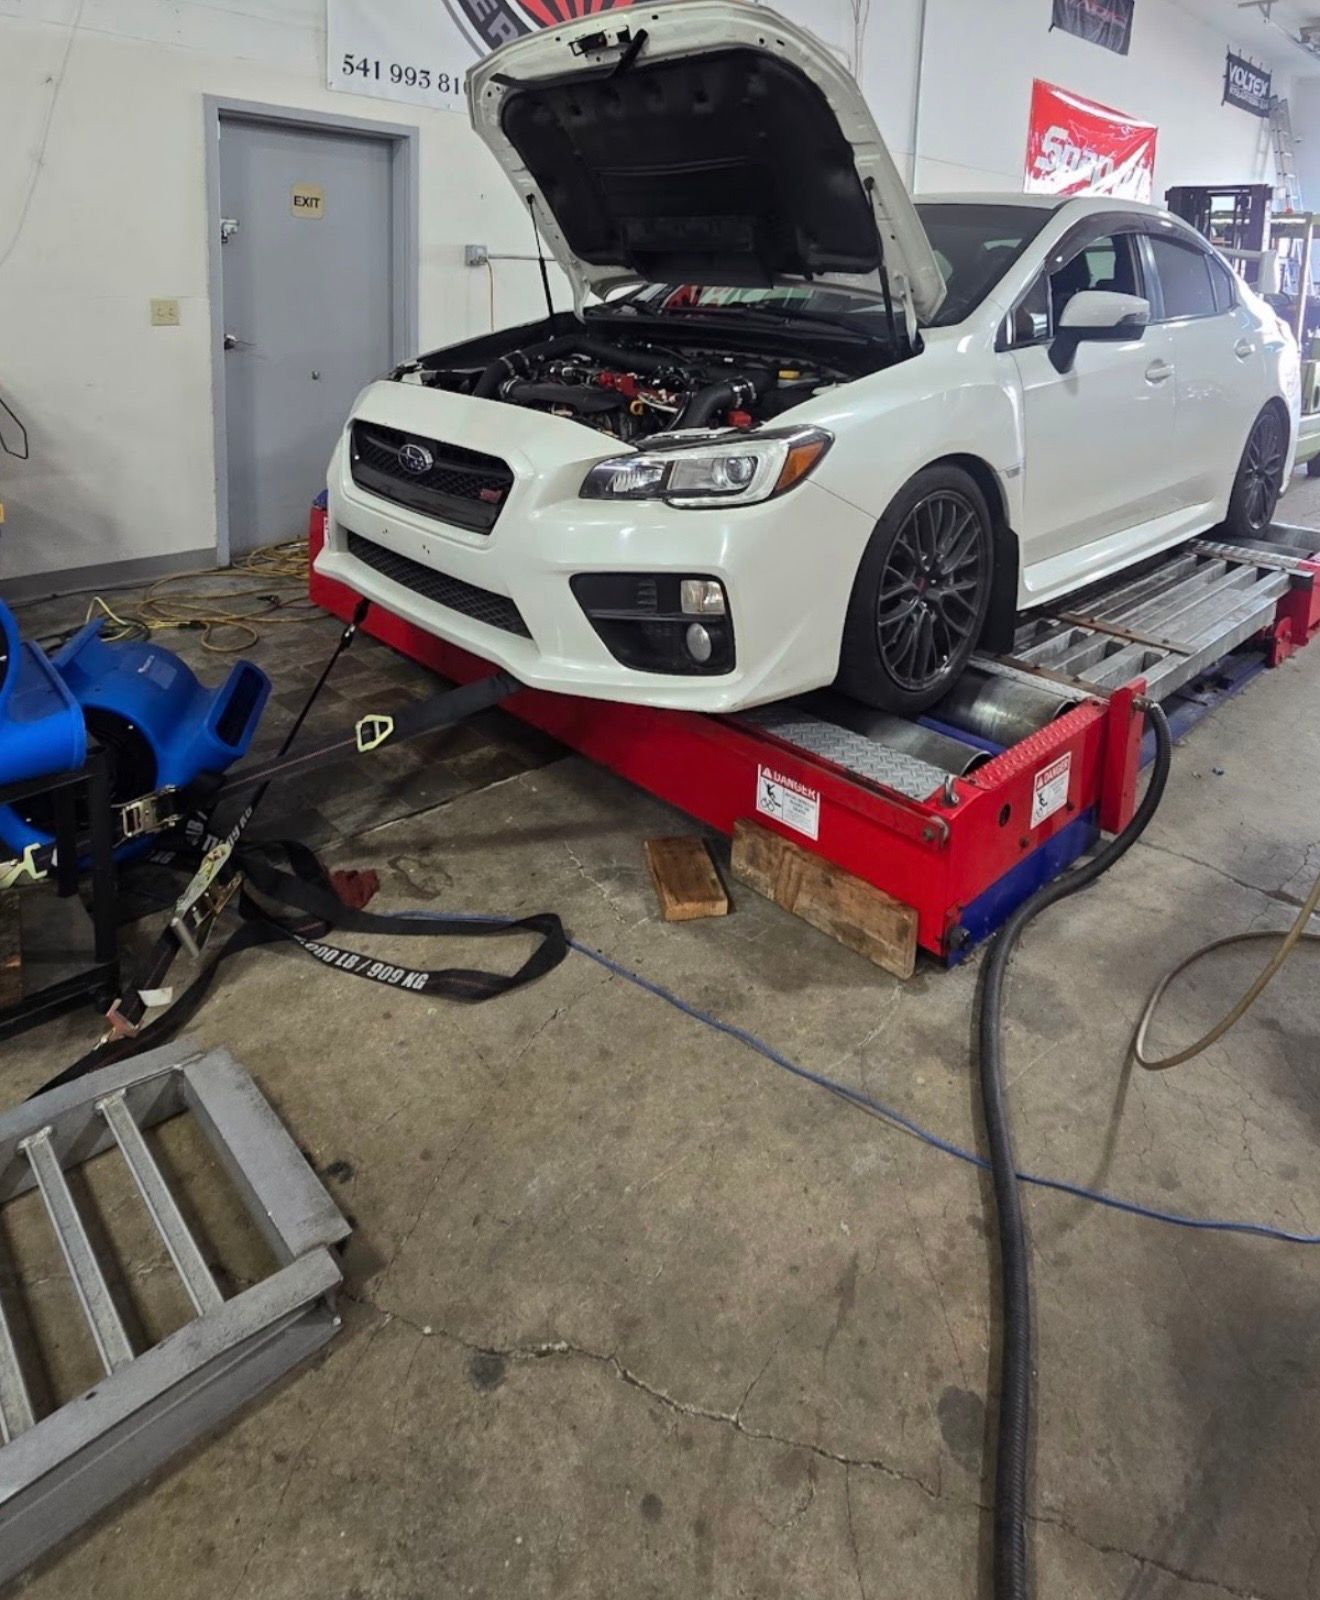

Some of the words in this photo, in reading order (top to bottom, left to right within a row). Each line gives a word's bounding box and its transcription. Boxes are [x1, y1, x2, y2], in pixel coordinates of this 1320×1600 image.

[342, 54, 380, 80] 541
[390, 63, 431, 89] 993
[1230, 62, 1268, 97] VOLTEX
[294, 195, 321, 208] EXIT
[773, 771, 816, 800] DANGER
[335, 953, 360, 969] LB
[367, 962, 404, 983] 909
[401, 971, 429, 990] KG
